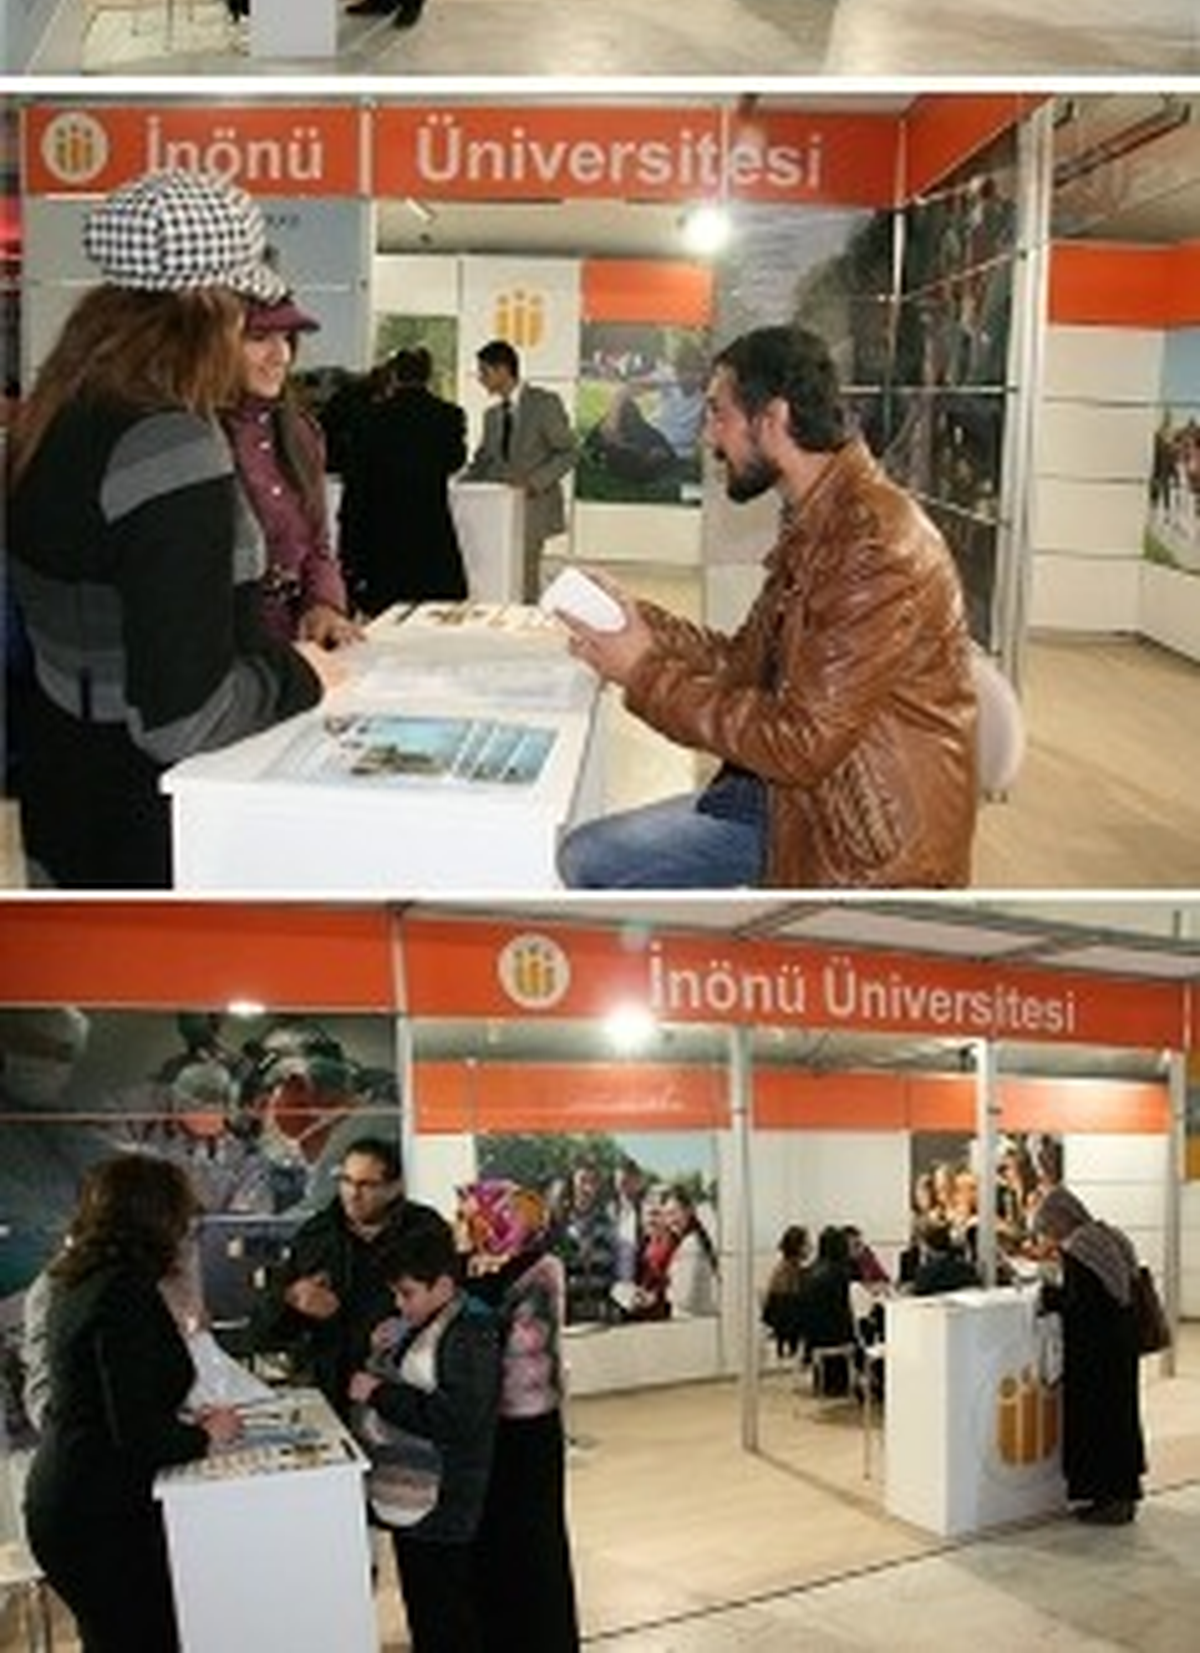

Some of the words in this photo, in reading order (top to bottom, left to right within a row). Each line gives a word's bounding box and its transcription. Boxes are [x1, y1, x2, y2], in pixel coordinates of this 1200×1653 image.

[146, 116, 322, 182] İnönü
[416, 115, 822, 187] Üniversitesi
[647, 943, 805, 1012] İnönü
[822, 957, 1075, 1032] Üniversitesi
